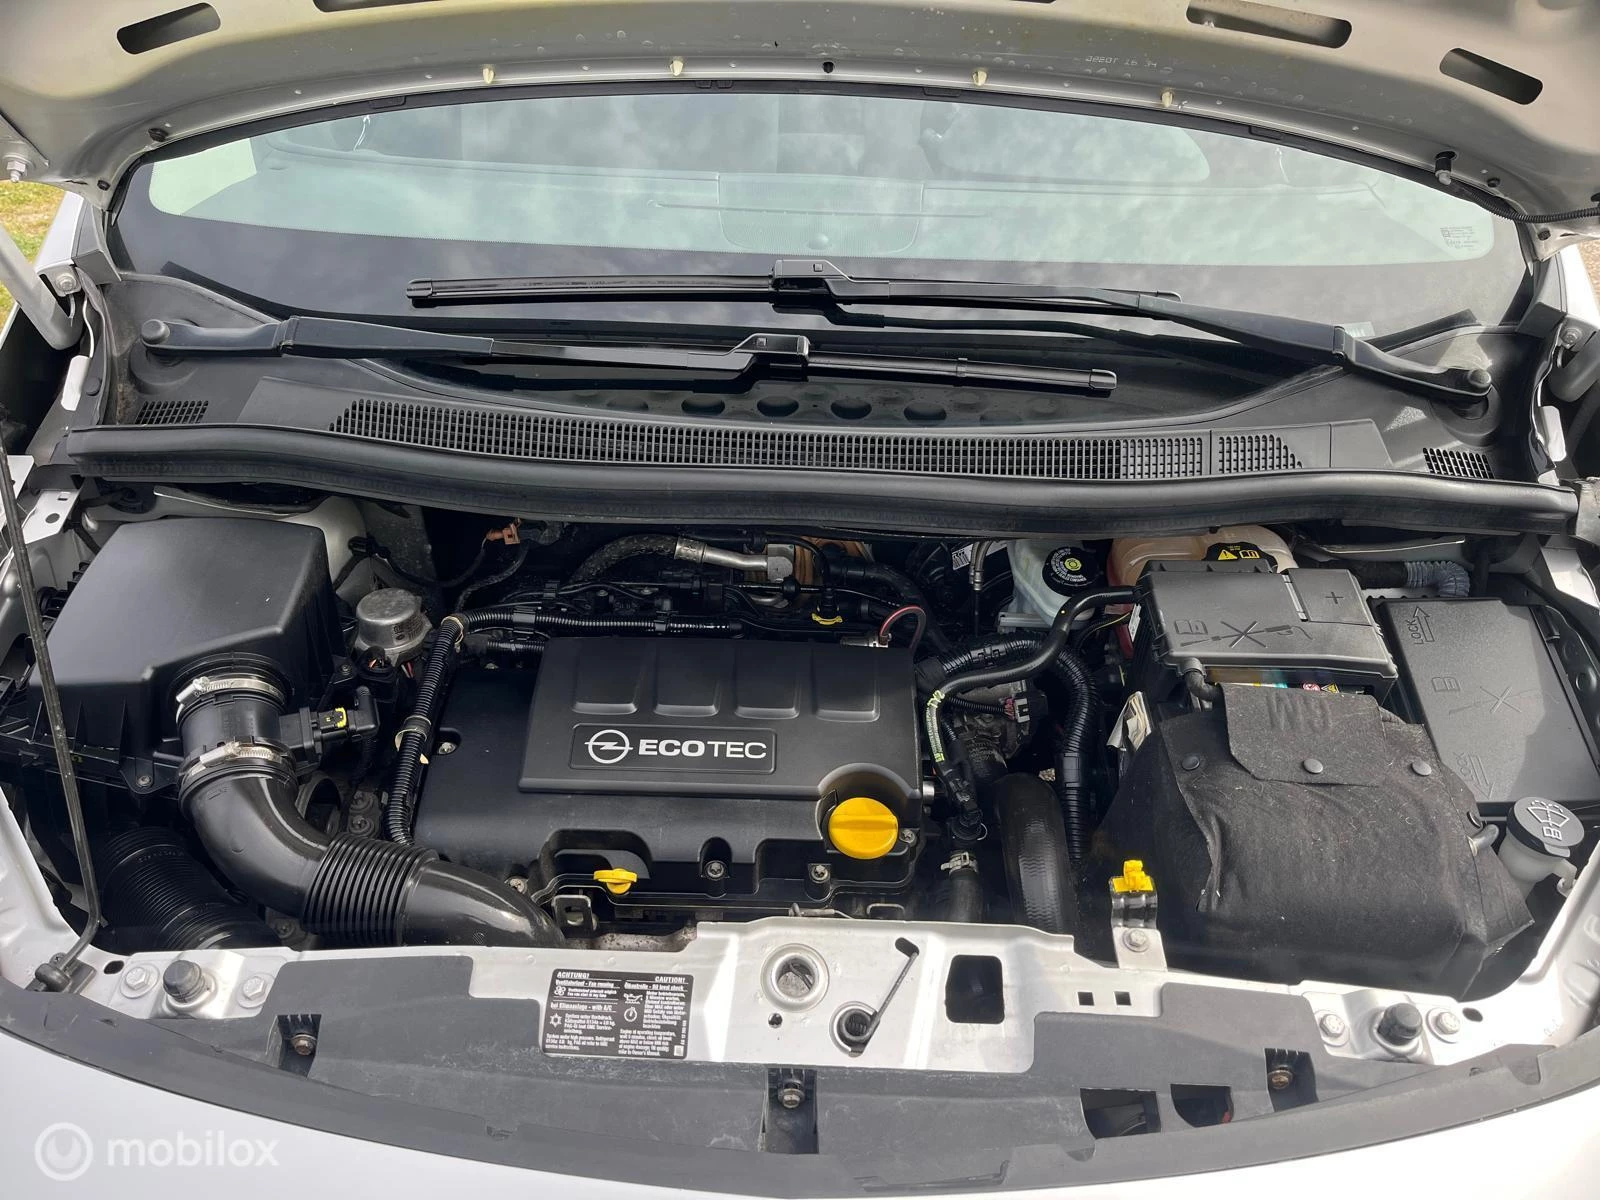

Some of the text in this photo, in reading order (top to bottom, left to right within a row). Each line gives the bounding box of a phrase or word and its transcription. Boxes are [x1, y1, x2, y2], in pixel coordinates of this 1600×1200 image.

[1405, 619, 1424, 645] LOCK
[638, 739, 767, 759] ECOTEC
[1452, 751, 1474, 782] LOCK
